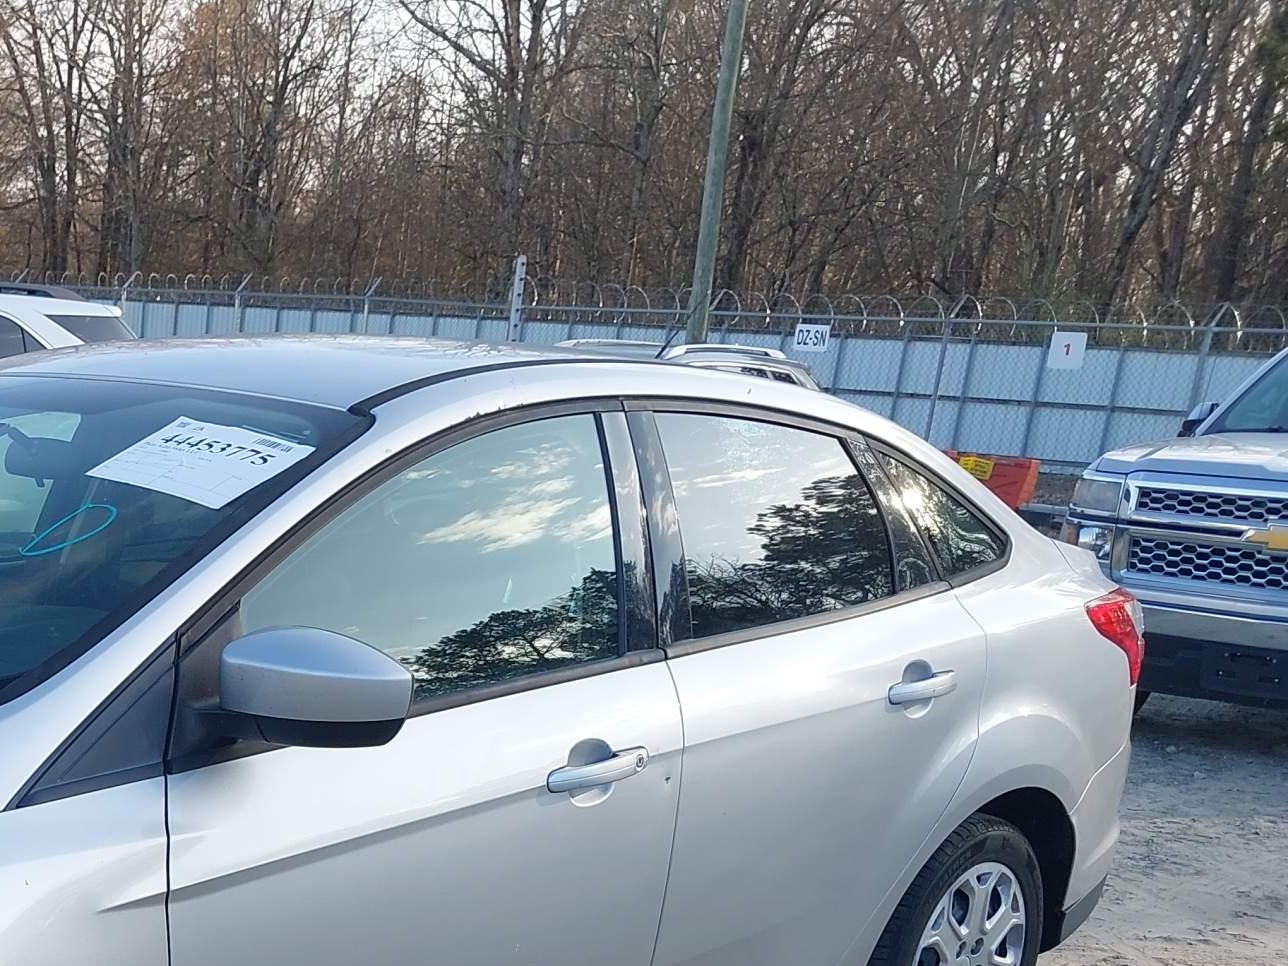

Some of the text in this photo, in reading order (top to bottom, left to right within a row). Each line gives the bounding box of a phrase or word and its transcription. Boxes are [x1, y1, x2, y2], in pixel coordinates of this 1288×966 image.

[796, 329, 828, 347] DZ-SN
[1063, 343, 1071, 356] 1
[161, 433, 277, 466] 44453775
